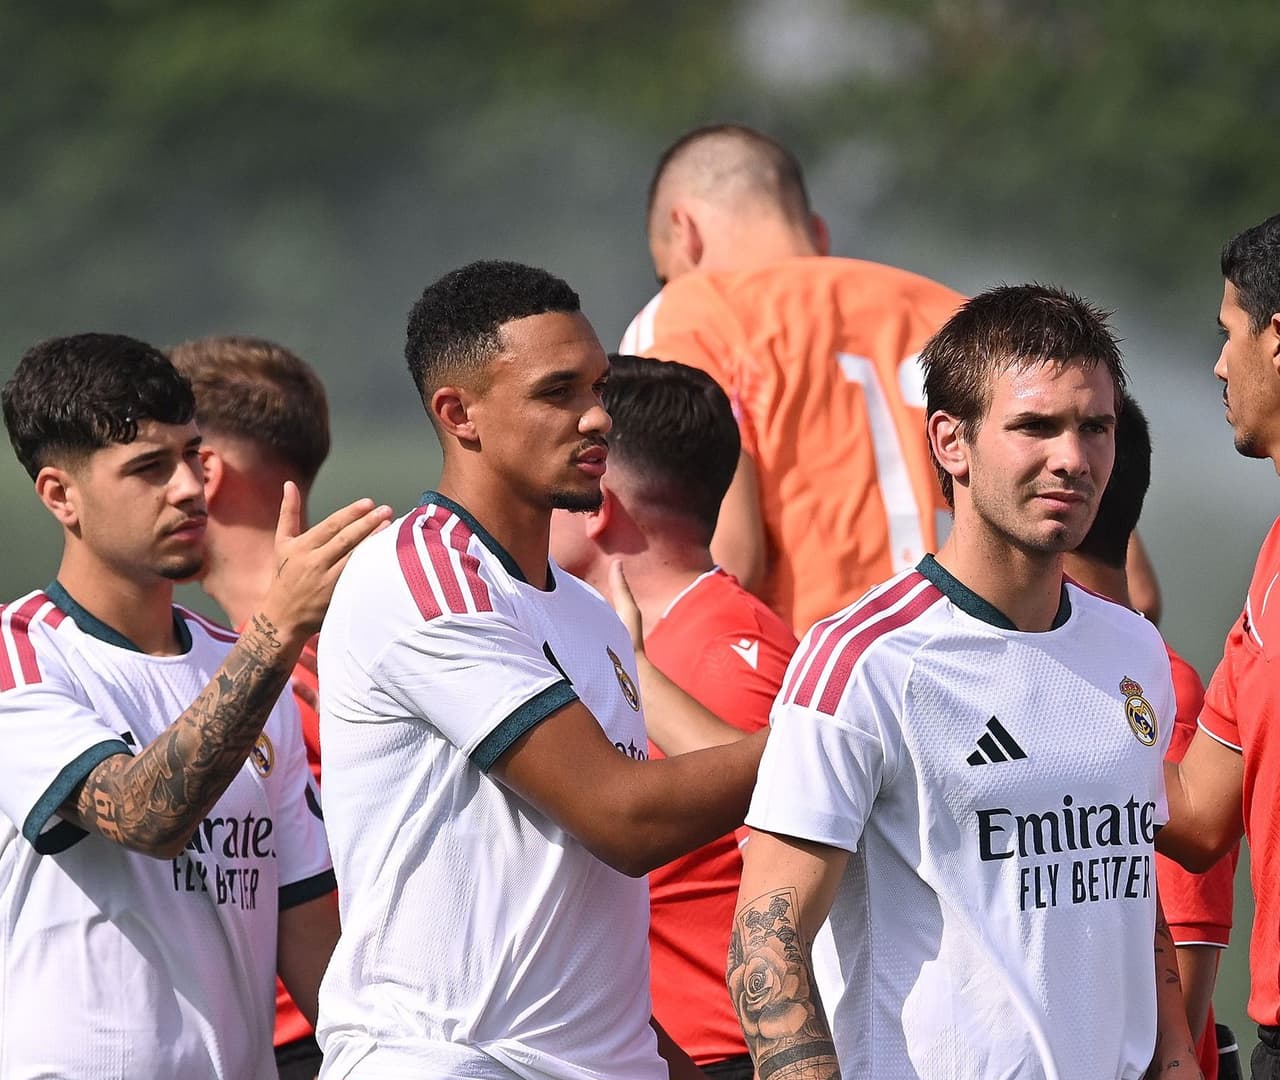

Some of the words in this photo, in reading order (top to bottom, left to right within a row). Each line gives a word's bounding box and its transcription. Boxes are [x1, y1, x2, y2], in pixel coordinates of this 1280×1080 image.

[836, 351, 952, 576] 1
[975, 794, 1156, 861] Emirate
[1020, 863, 1059, 911] FLY
[1072, 855, 1151, 904] BETTER
